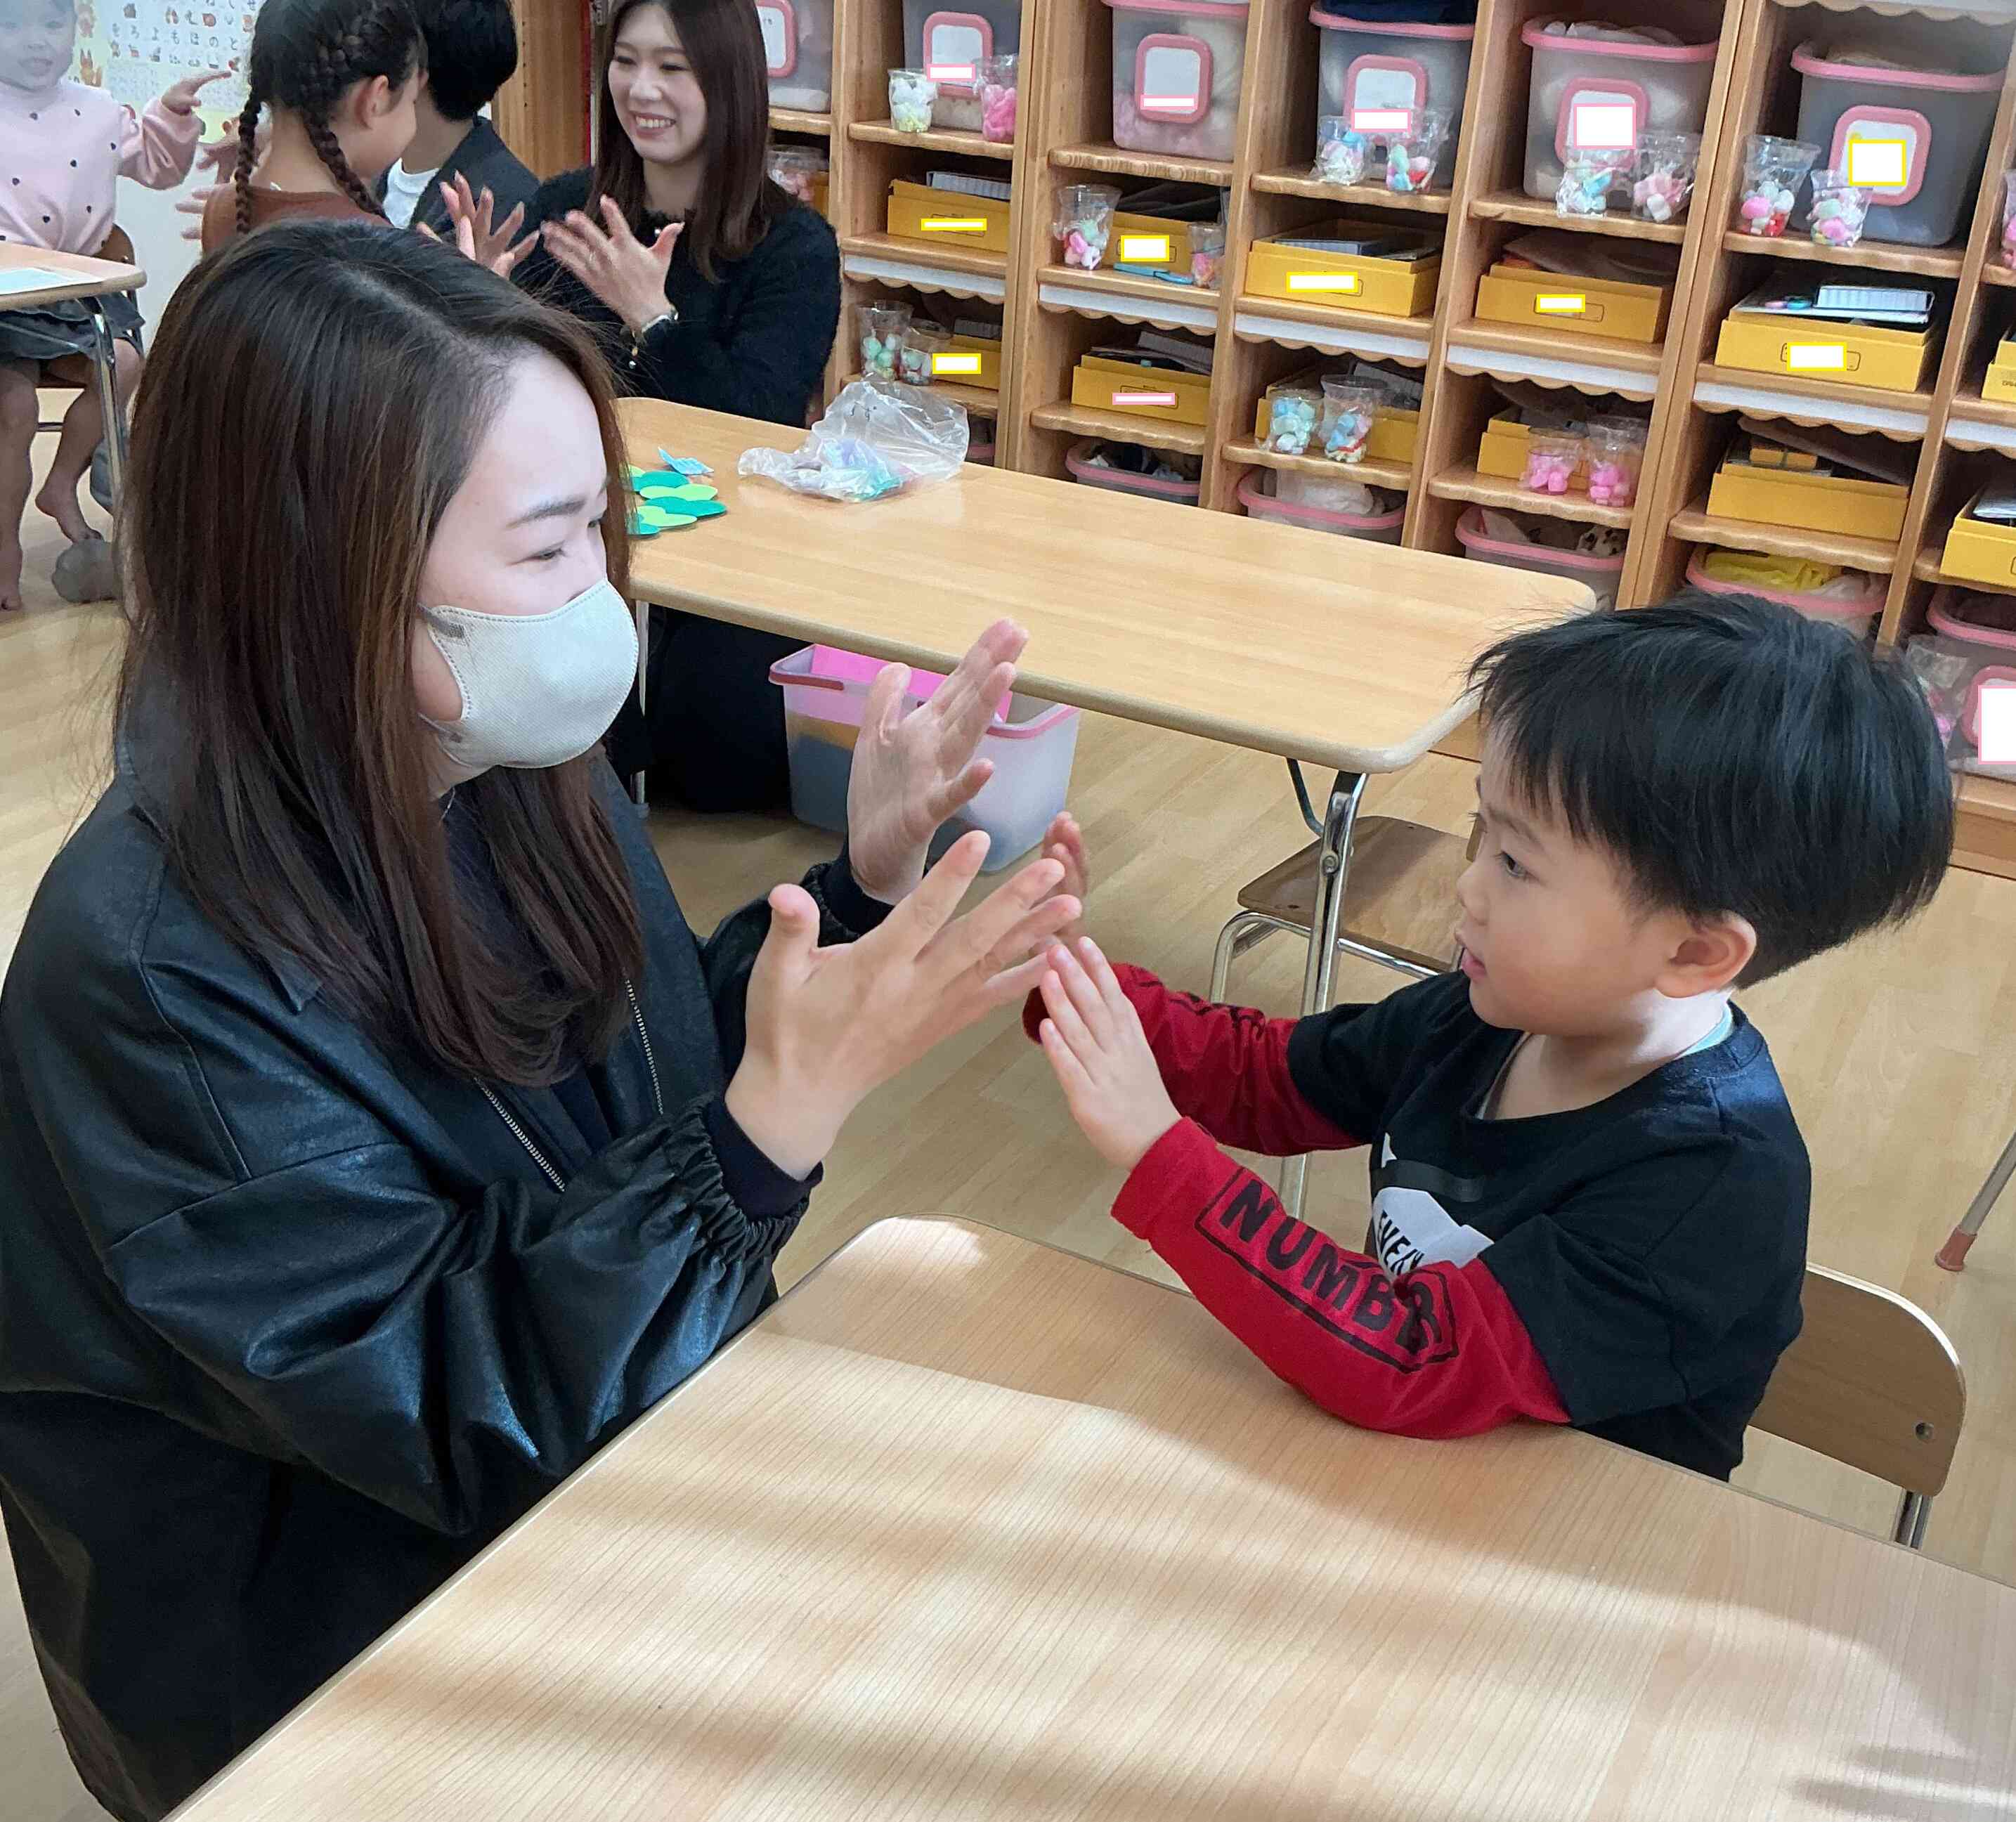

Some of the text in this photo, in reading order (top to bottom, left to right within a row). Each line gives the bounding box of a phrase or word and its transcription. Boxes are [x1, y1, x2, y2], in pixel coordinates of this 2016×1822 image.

[171, 30, 179, 44] も
[209, 36, 219, 47] の
[230, 37, 238, 51] と
